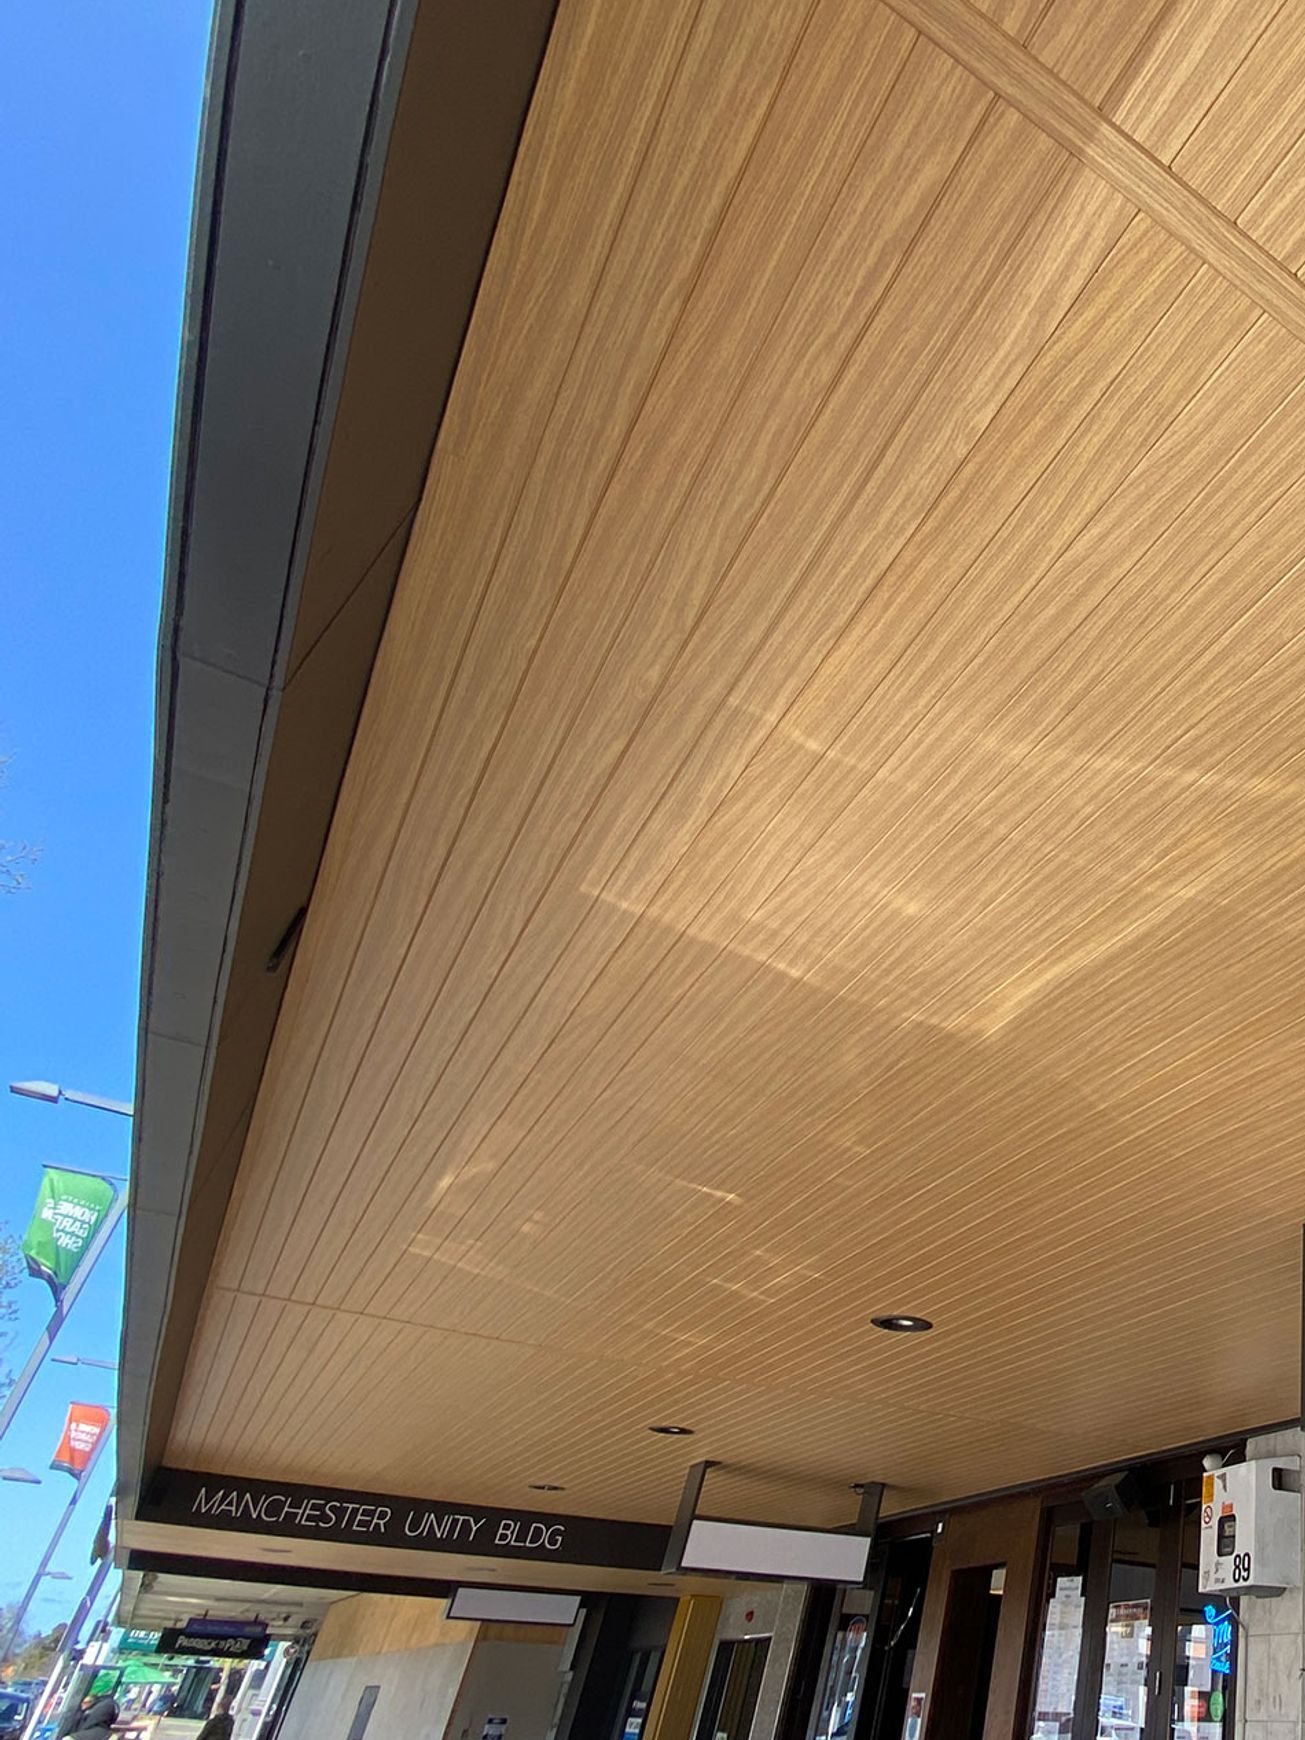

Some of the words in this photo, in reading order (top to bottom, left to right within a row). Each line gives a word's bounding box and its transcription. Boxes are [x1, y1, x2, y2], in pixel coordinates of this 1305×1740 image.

[191, 1486, 392, 1534] MANCHESTER
[404, 1510, 487, 1542] UNITY
[1232, 1552, 1252, 1583] 89
